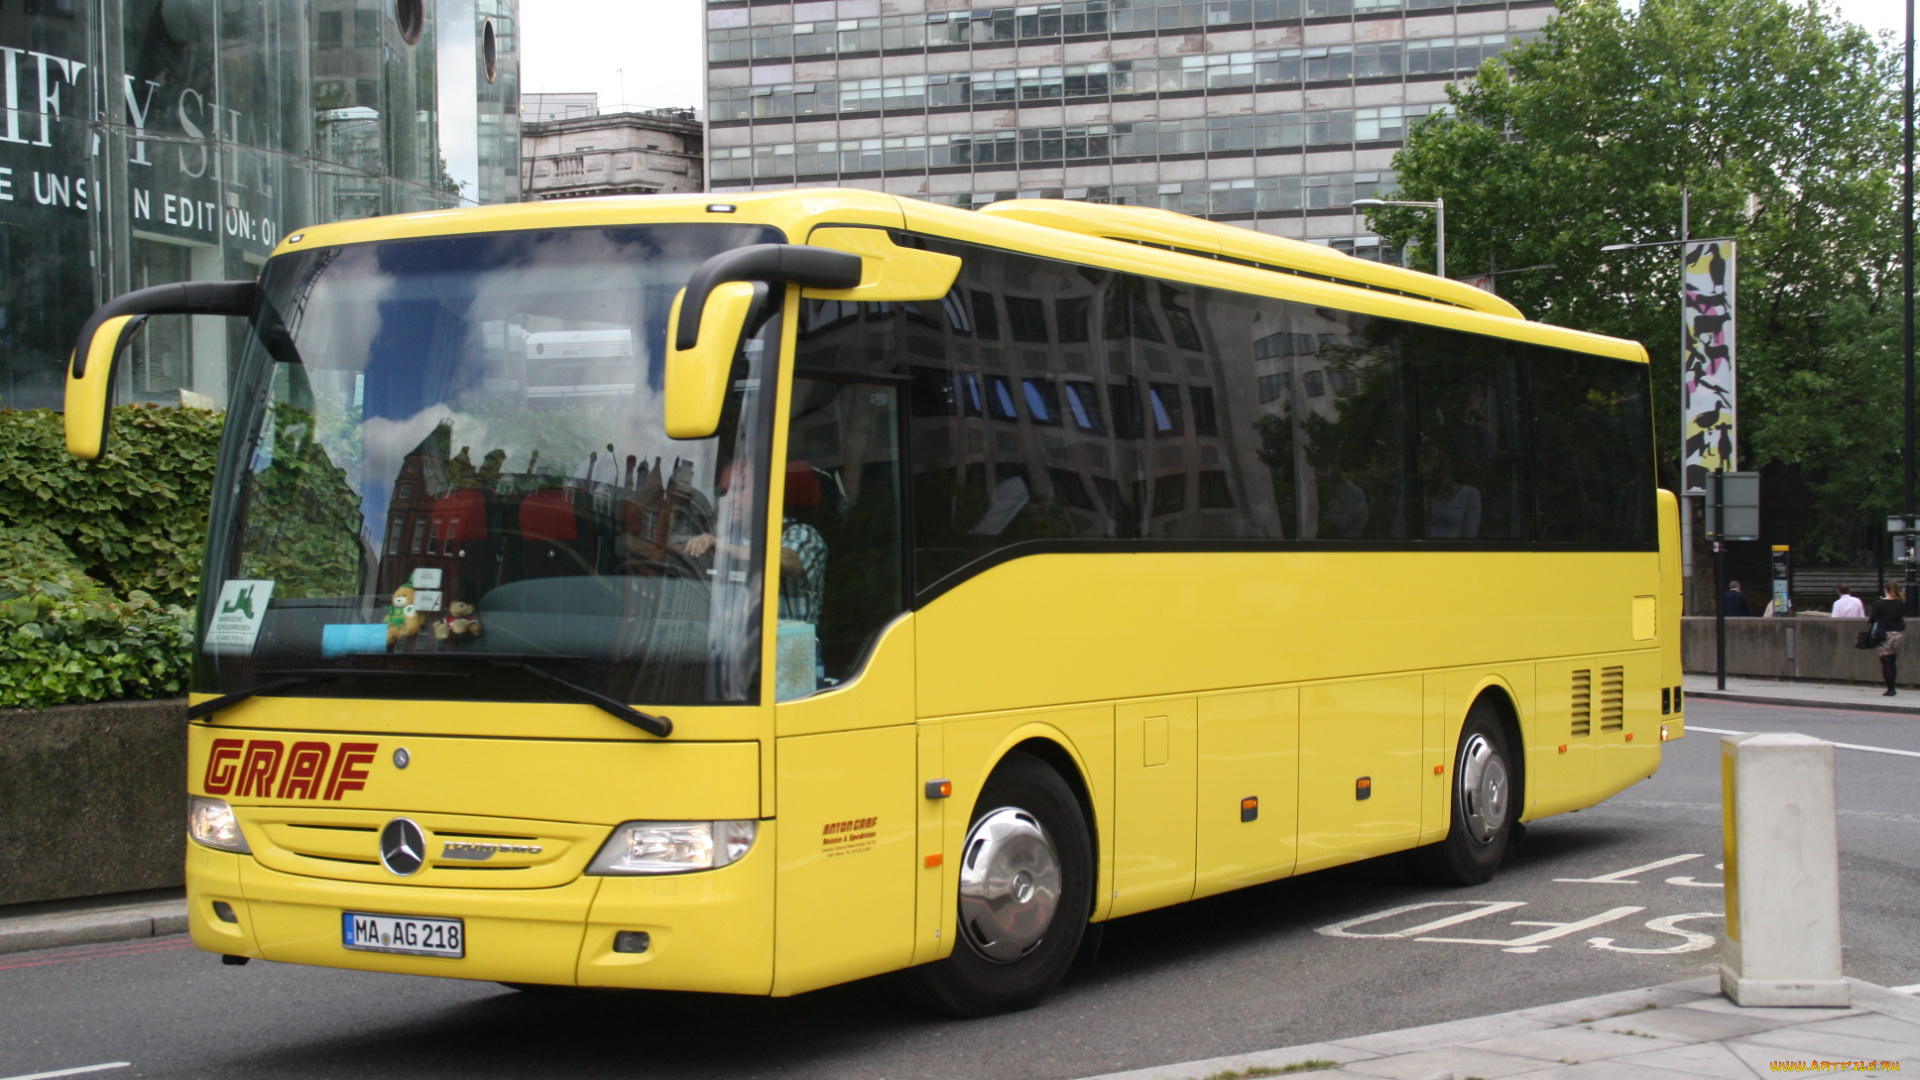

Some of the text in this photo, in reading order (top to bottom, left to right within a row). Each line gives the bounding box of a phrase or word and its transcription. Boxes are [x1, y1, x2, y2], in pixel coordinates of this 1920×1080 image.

[203, 738, 379, 801] GRAF
[442, 841, 543, 855] TOURISMO
[355, 919, 380, 944] MA
[393, 921, 418, 947] AG
[422, 923, 460, 950] 218
